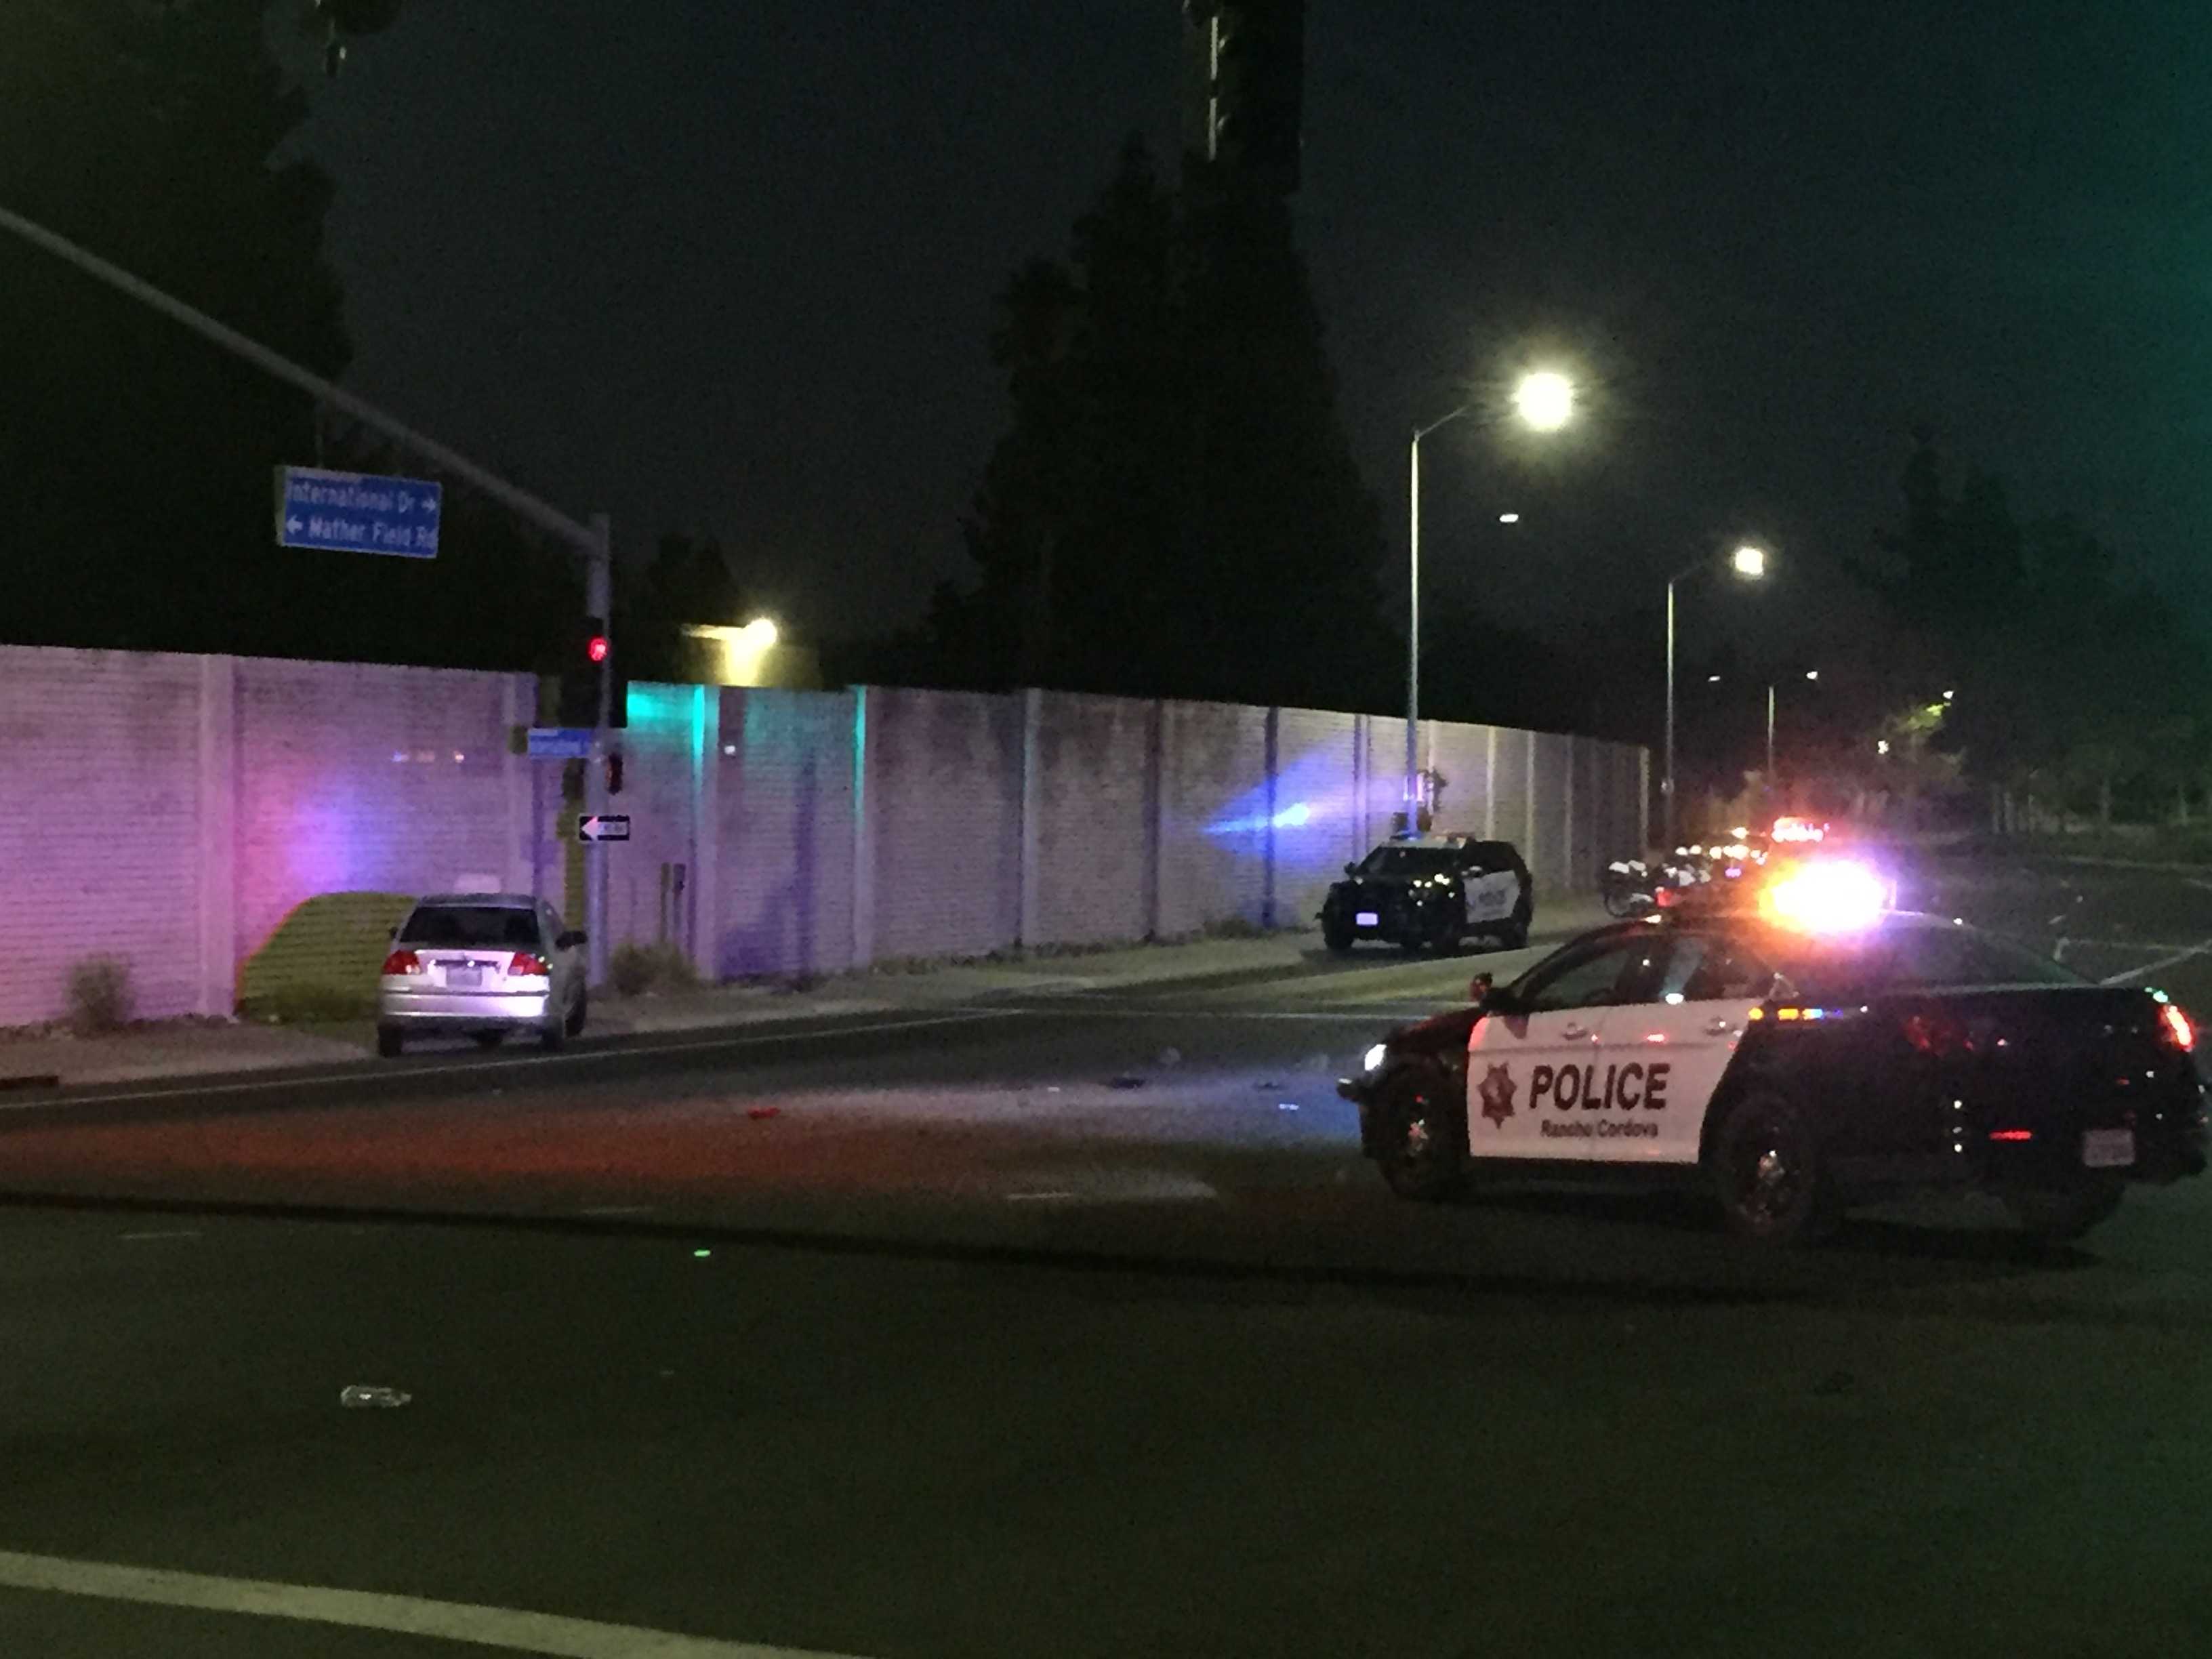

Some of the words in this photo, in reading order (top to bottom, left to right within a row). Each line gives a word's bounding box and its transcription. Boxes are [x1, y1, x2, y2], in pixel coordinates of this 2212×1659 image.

[1529, 1062, 1671, 1111] POLICE
[1540, 1119, 1592, 1138] Rancho
[1597, 1118, 1658, 1139] Cordova
